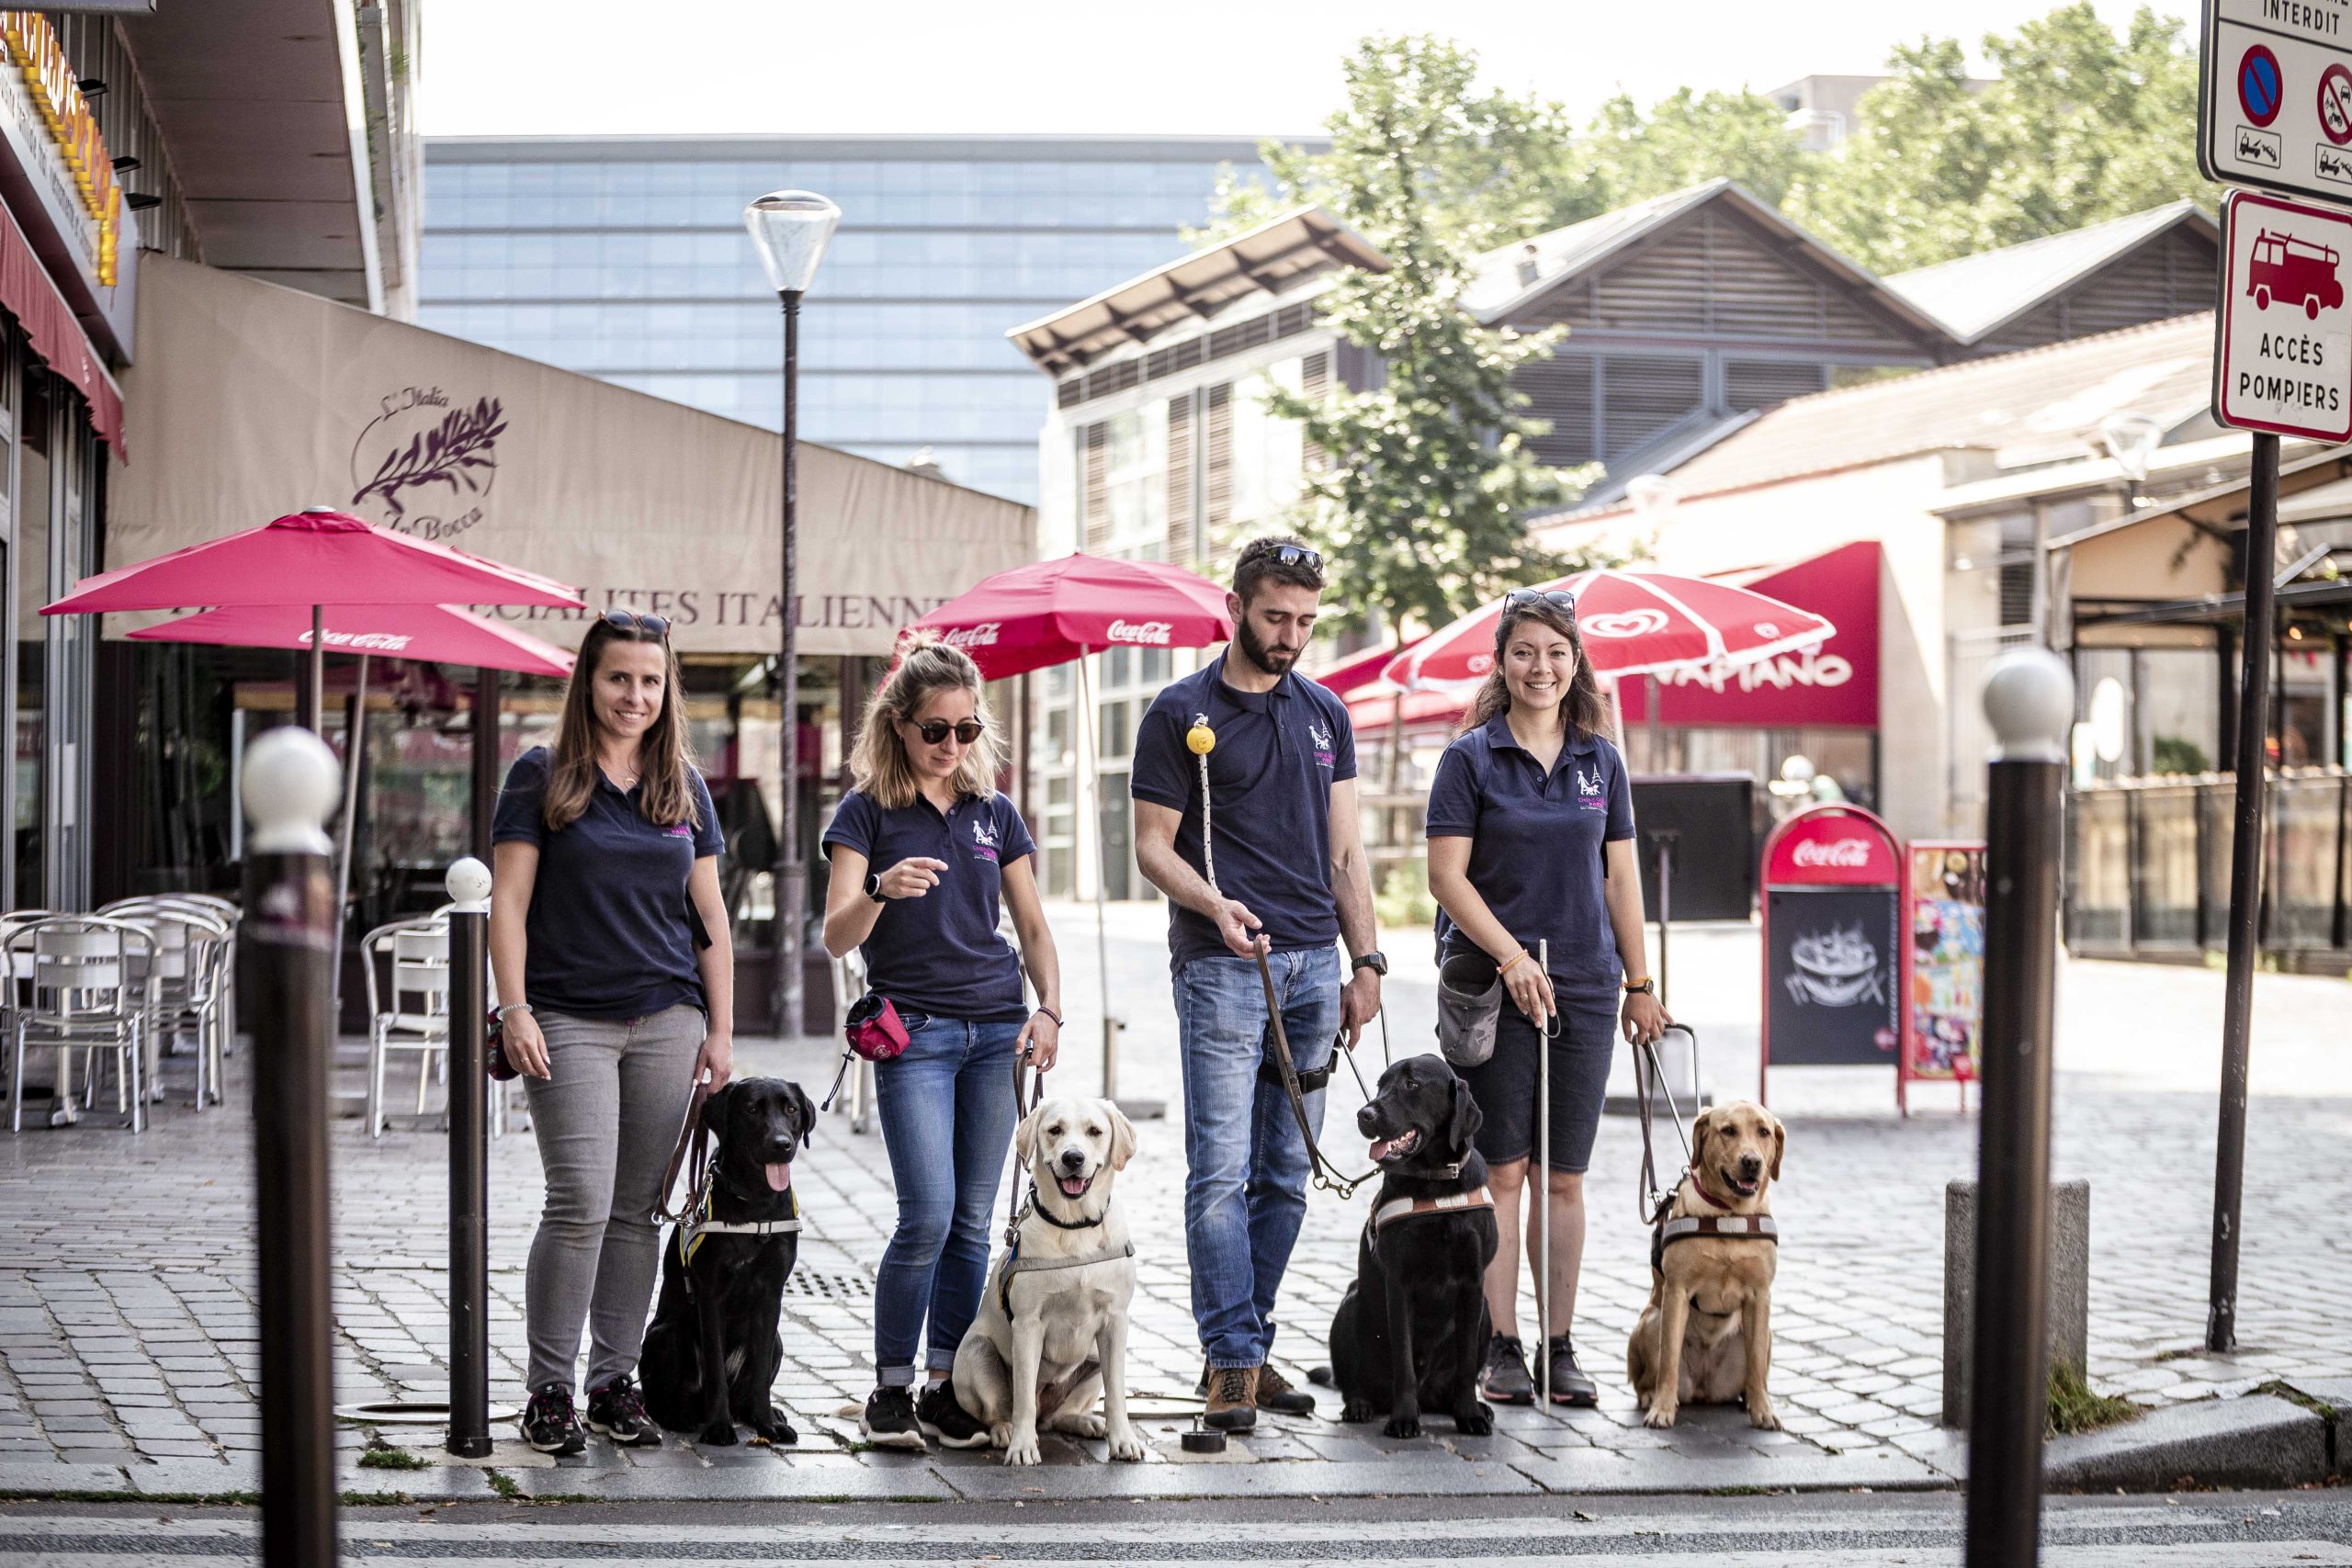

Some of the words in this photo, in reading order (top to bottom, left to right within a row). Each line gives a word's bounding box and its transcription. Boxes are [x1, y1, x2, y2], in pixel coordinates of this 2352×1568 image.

[2264, 0, 2340, 35] INTERDIT
[2260, 333, 2323, 366] ACCÈS
[2239, 372, 2339, 411] POMPIERS
[413, 506, 484, 541] Bocca
[1106, 619, 1174, 645] Coca-Cola
[1792, 838, 1871, 867] Coca-Cola
